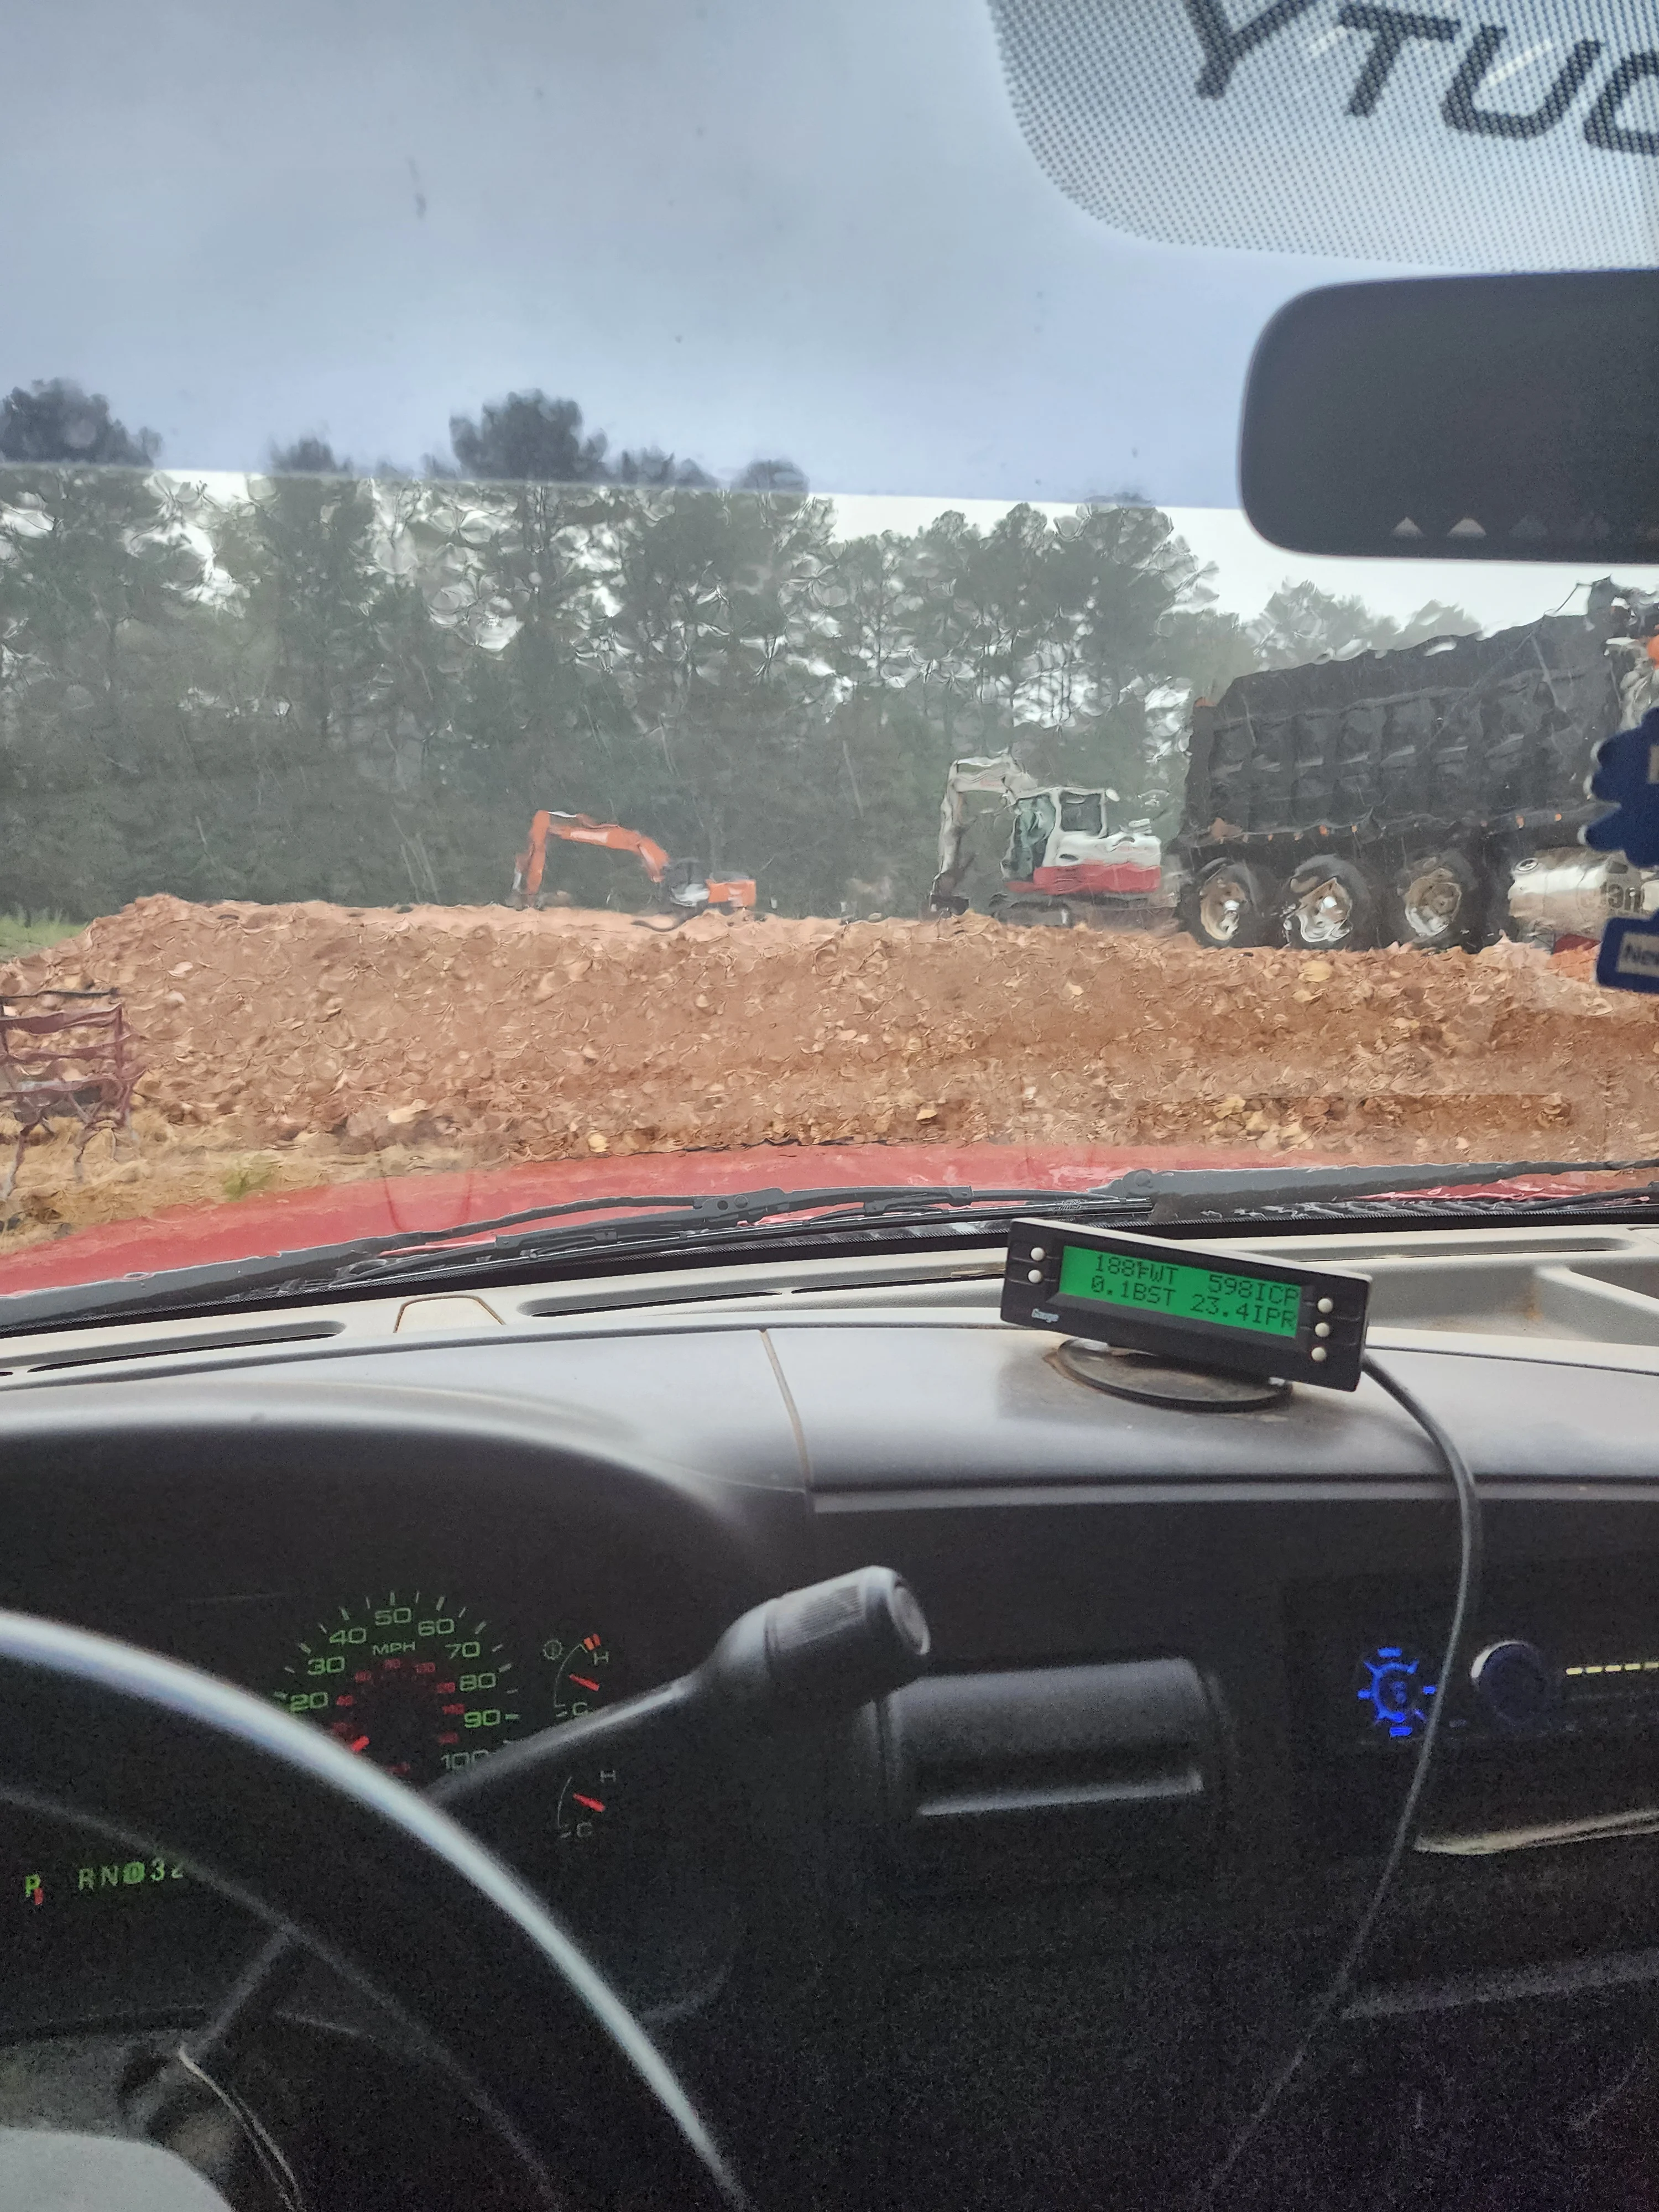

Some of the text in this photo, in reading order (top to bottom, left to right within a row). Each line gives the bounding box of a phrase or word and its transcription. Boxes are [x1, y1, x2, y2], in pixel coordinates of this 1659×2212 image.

[1208, 1274, 1298, 1306] 598ICP
[1092, 1275, 1296, 1330] 0.1BST 23.4IPR
[375, 1607, 412, 1626] 50
[329, 1627, 367, 1645] 40
[418, 1618, 455, 1637] 60
[372, 1641, 416, 1655] MPH
[445, 1641, 480, 1659] 70
[307, 1656, 345, 1676] 30
[459, 1672, 497, 1692] 80
[289, 1692, 329, 1712] 20
[463, 1709, 501, 1729] 90
